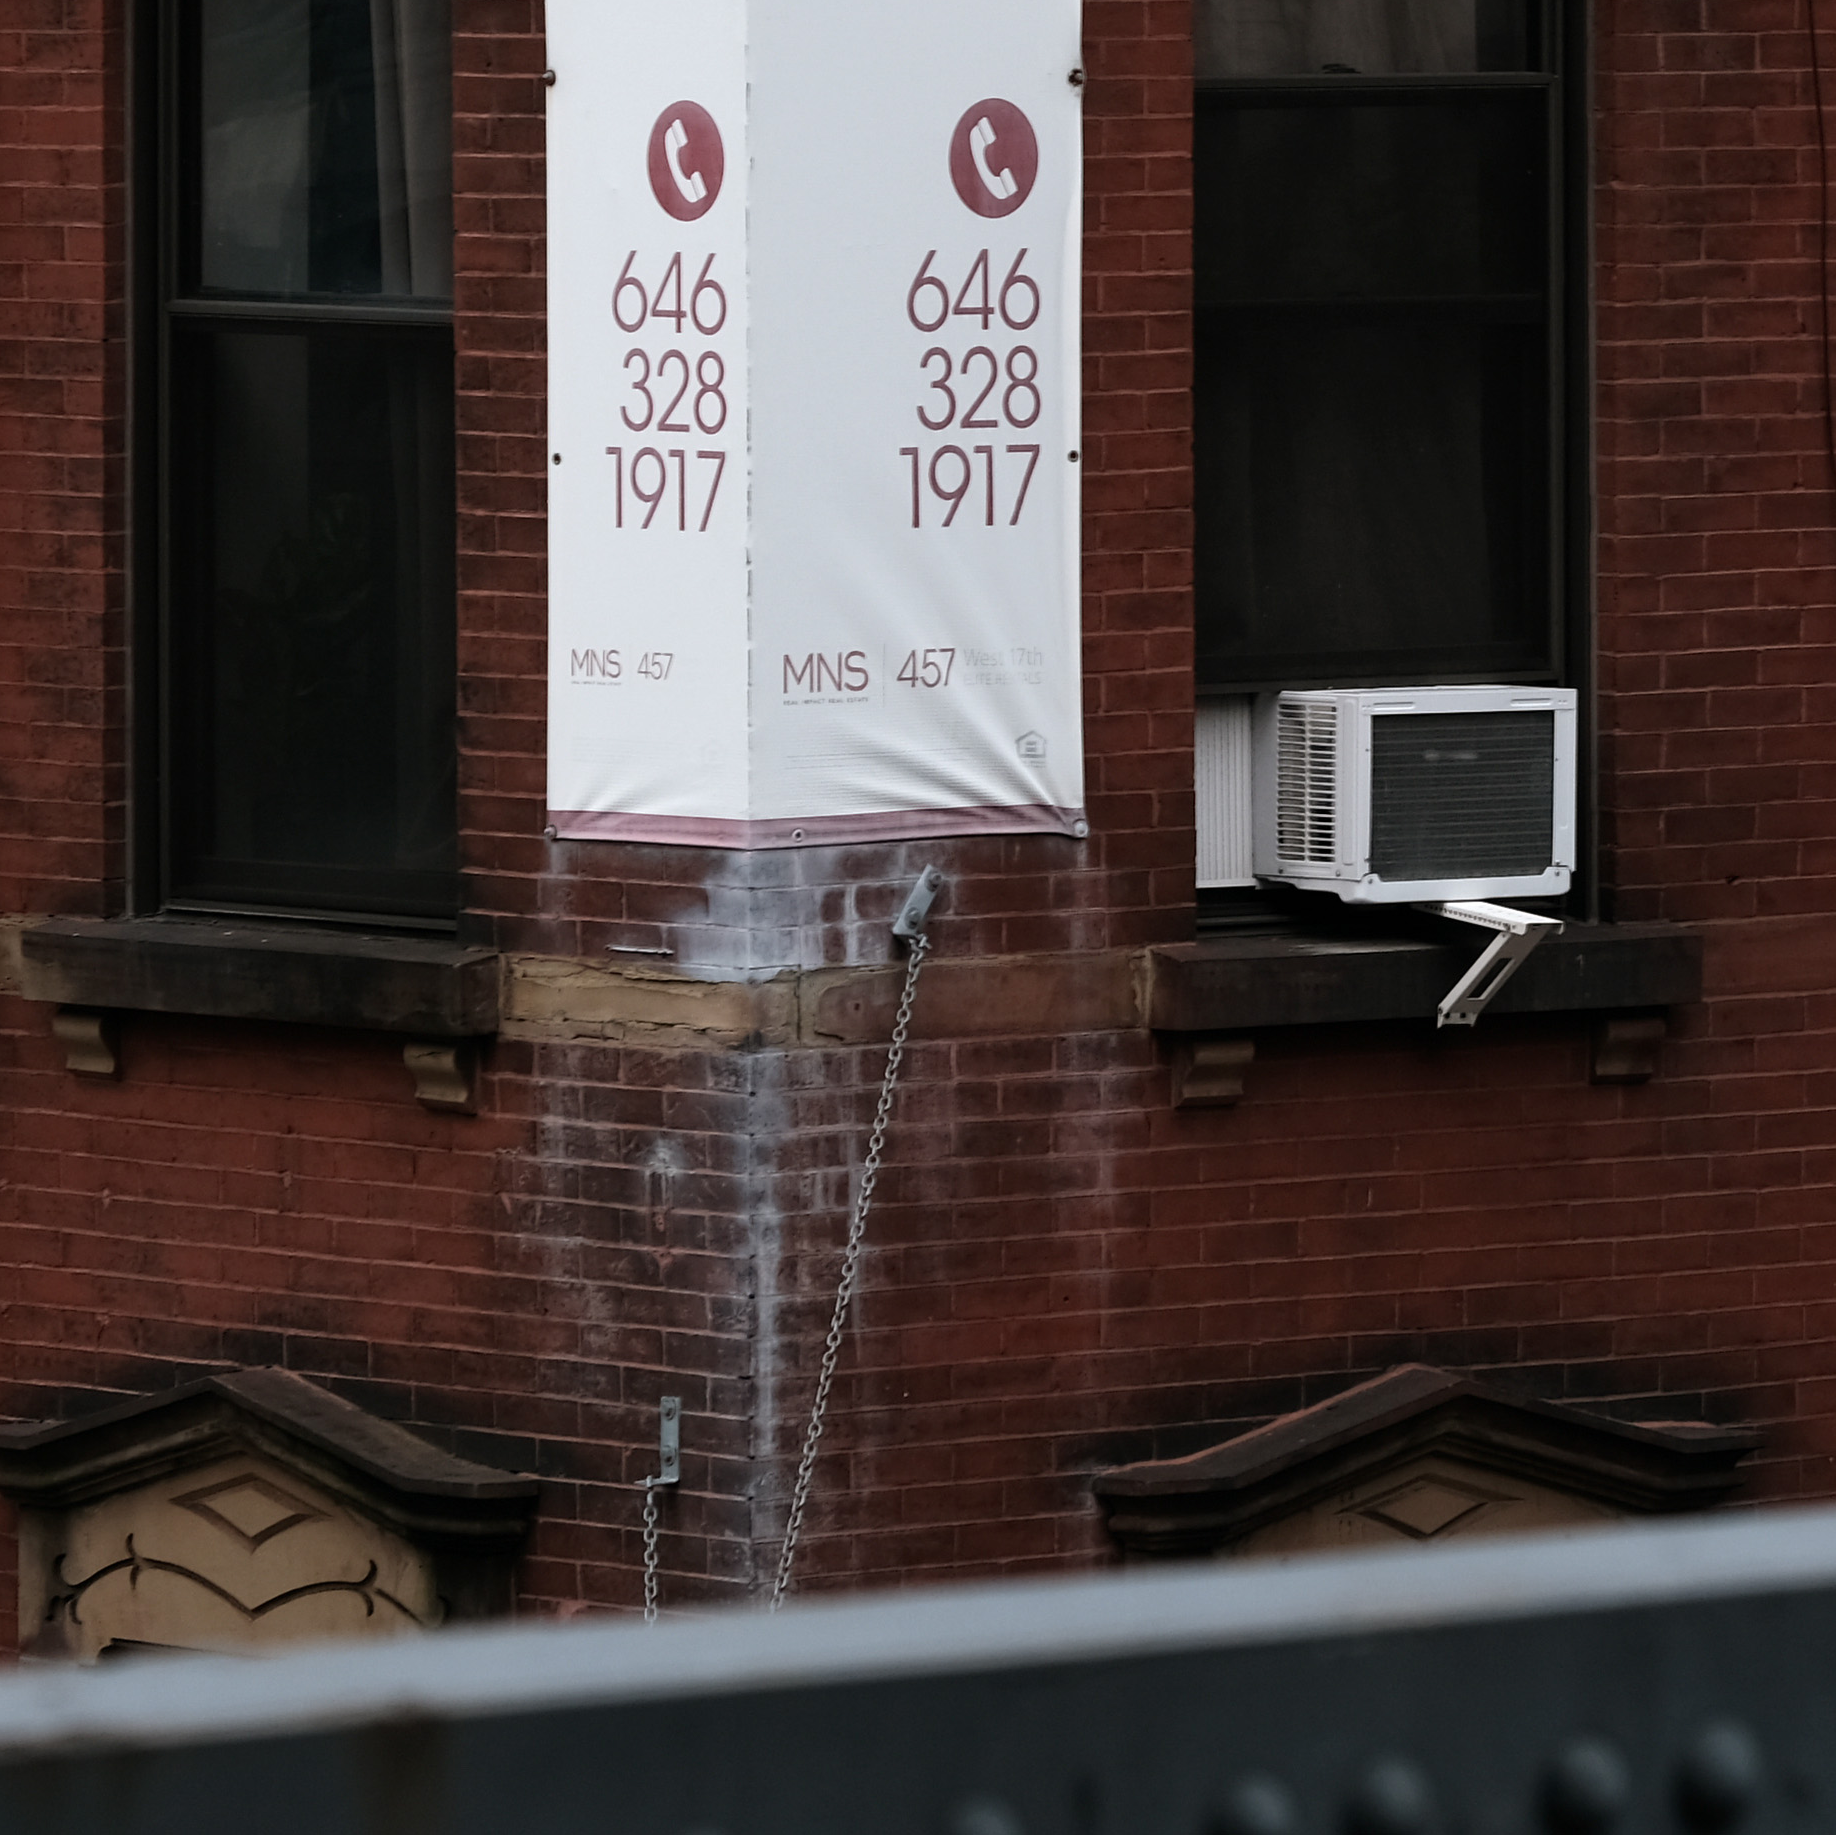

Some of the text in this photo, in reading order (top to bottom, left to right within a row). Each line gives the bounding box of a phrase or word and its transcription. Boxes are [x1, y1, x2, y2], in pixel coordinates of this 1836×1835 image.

[611, 249, 727, 335] 646
[906, 247, 1041, 332] 646
[619, 347, 727, 434] 328
[916, 345, 1042, 430] 328
[605, 446, 726, 532] 1917
[899, 444, 1041, 528] 1917
[570, 648, 622, 679] MNS
[636, 651, 674, 681] 457
[782, 650, 869, 694] MNS
[896, 647, 956, 689] 457
